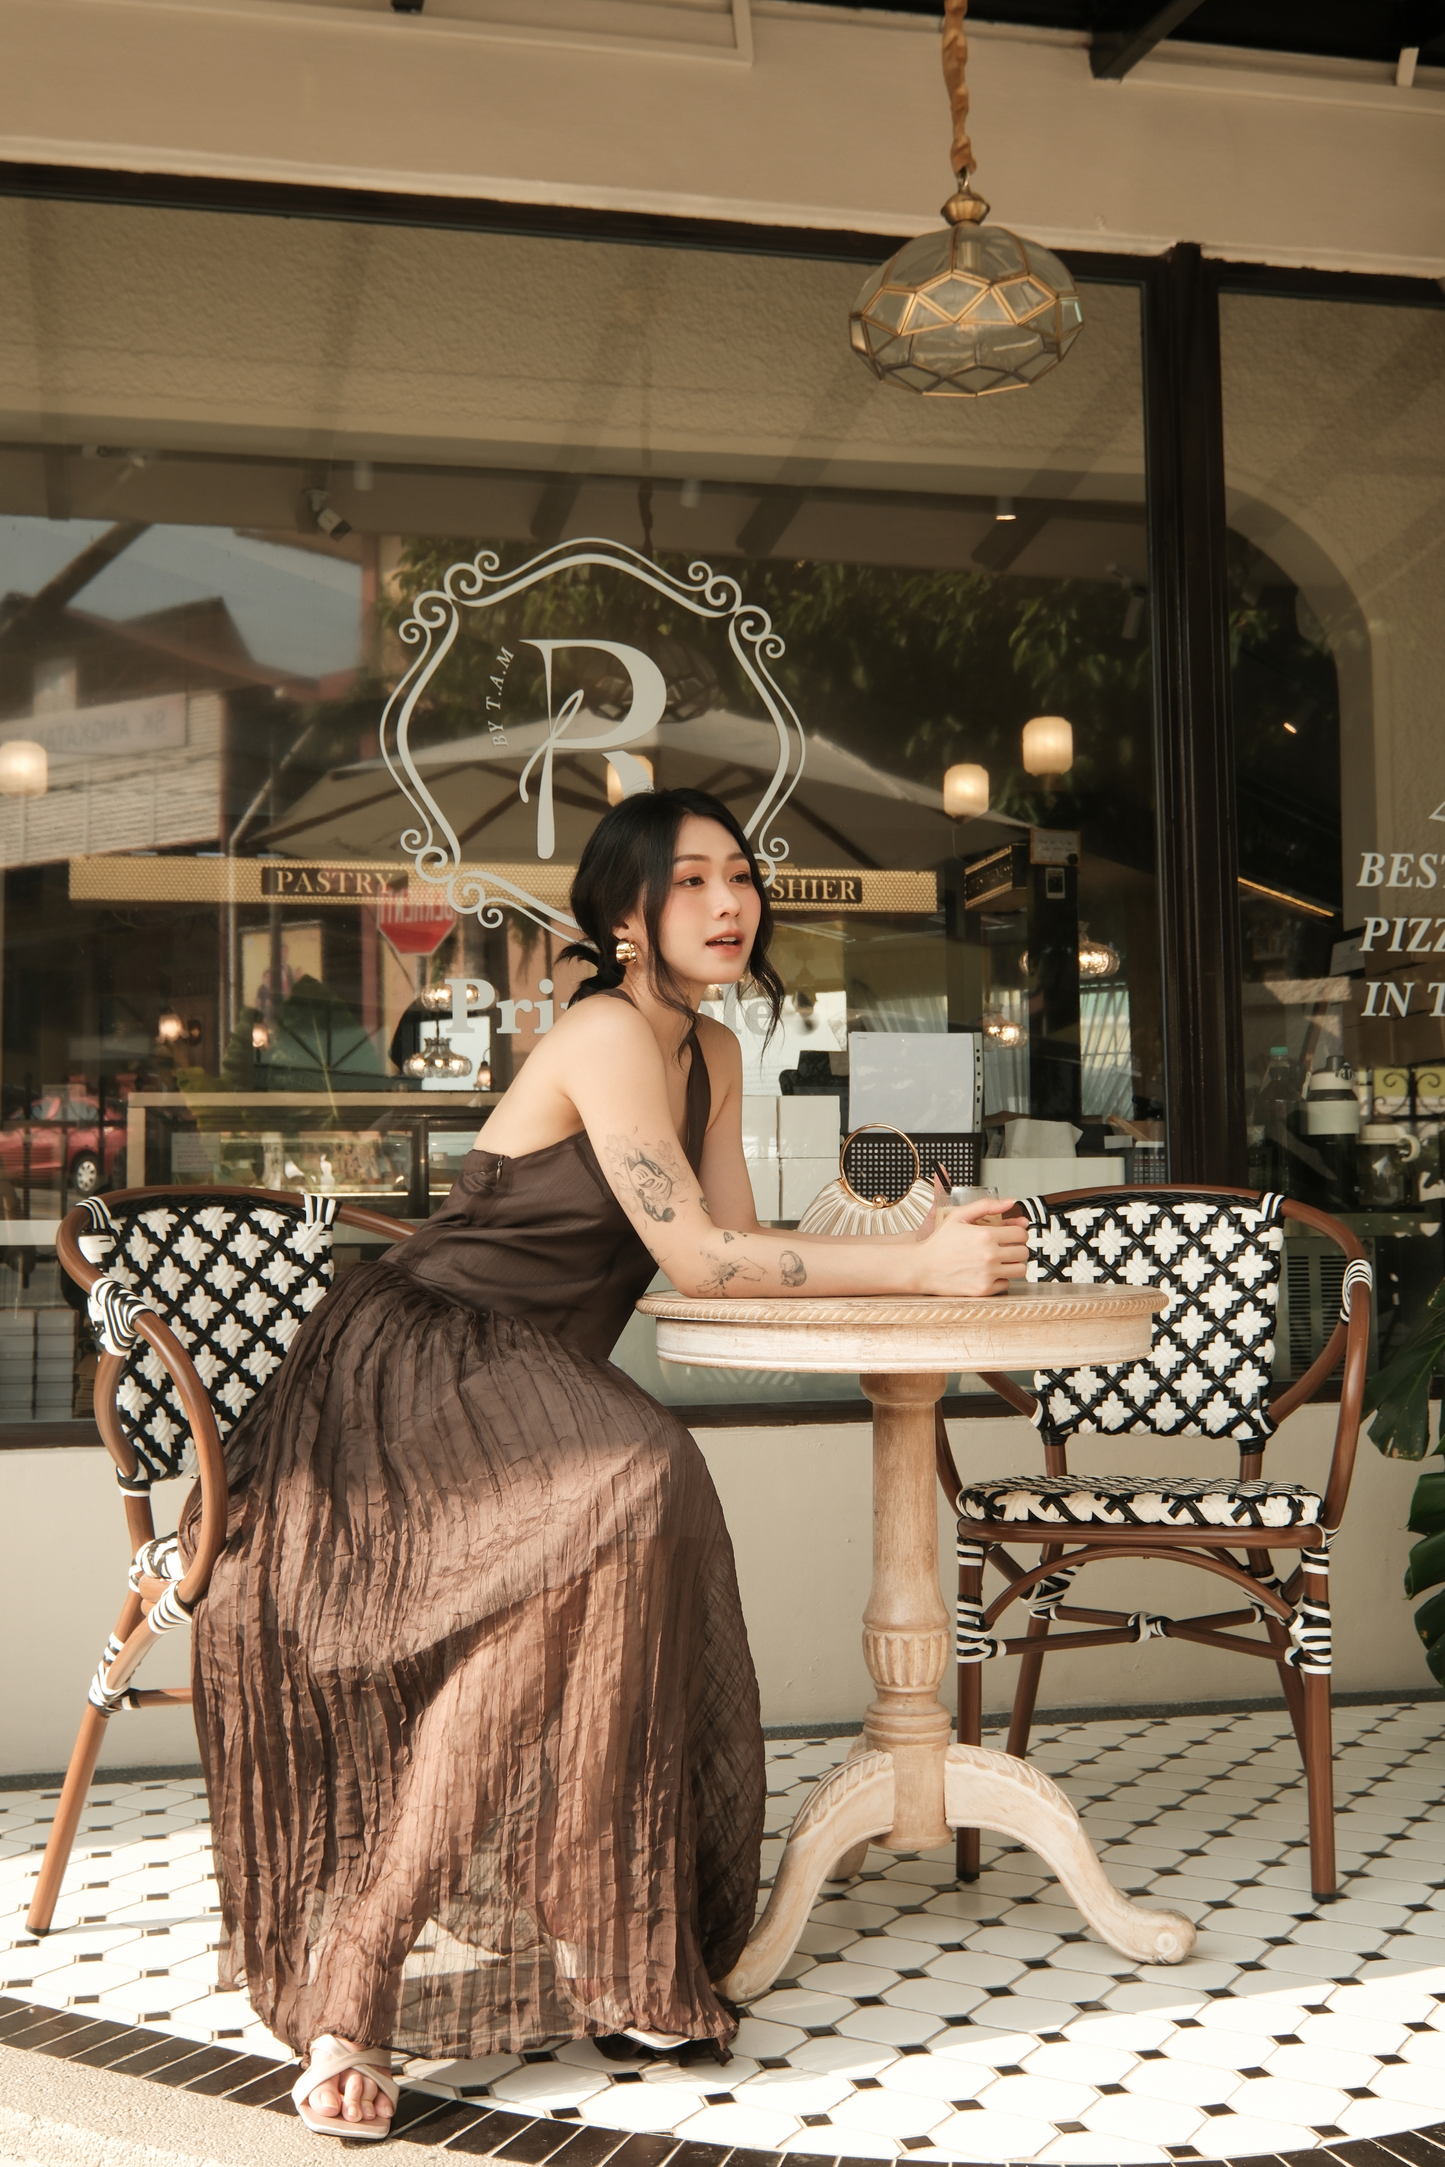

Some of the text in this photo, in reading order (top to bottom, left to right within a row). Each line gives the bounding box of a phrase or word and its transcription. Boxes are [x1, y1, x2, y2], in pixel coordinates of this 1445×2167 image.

[485, 645, 514, 747] BY T.A.M
[276, 870, 393, 894] PASTRY
[771, 877, 857, 900] SHIER
[1356, 852, 1445, 889] BES
[1360, 981, 1415, 1017] IN
